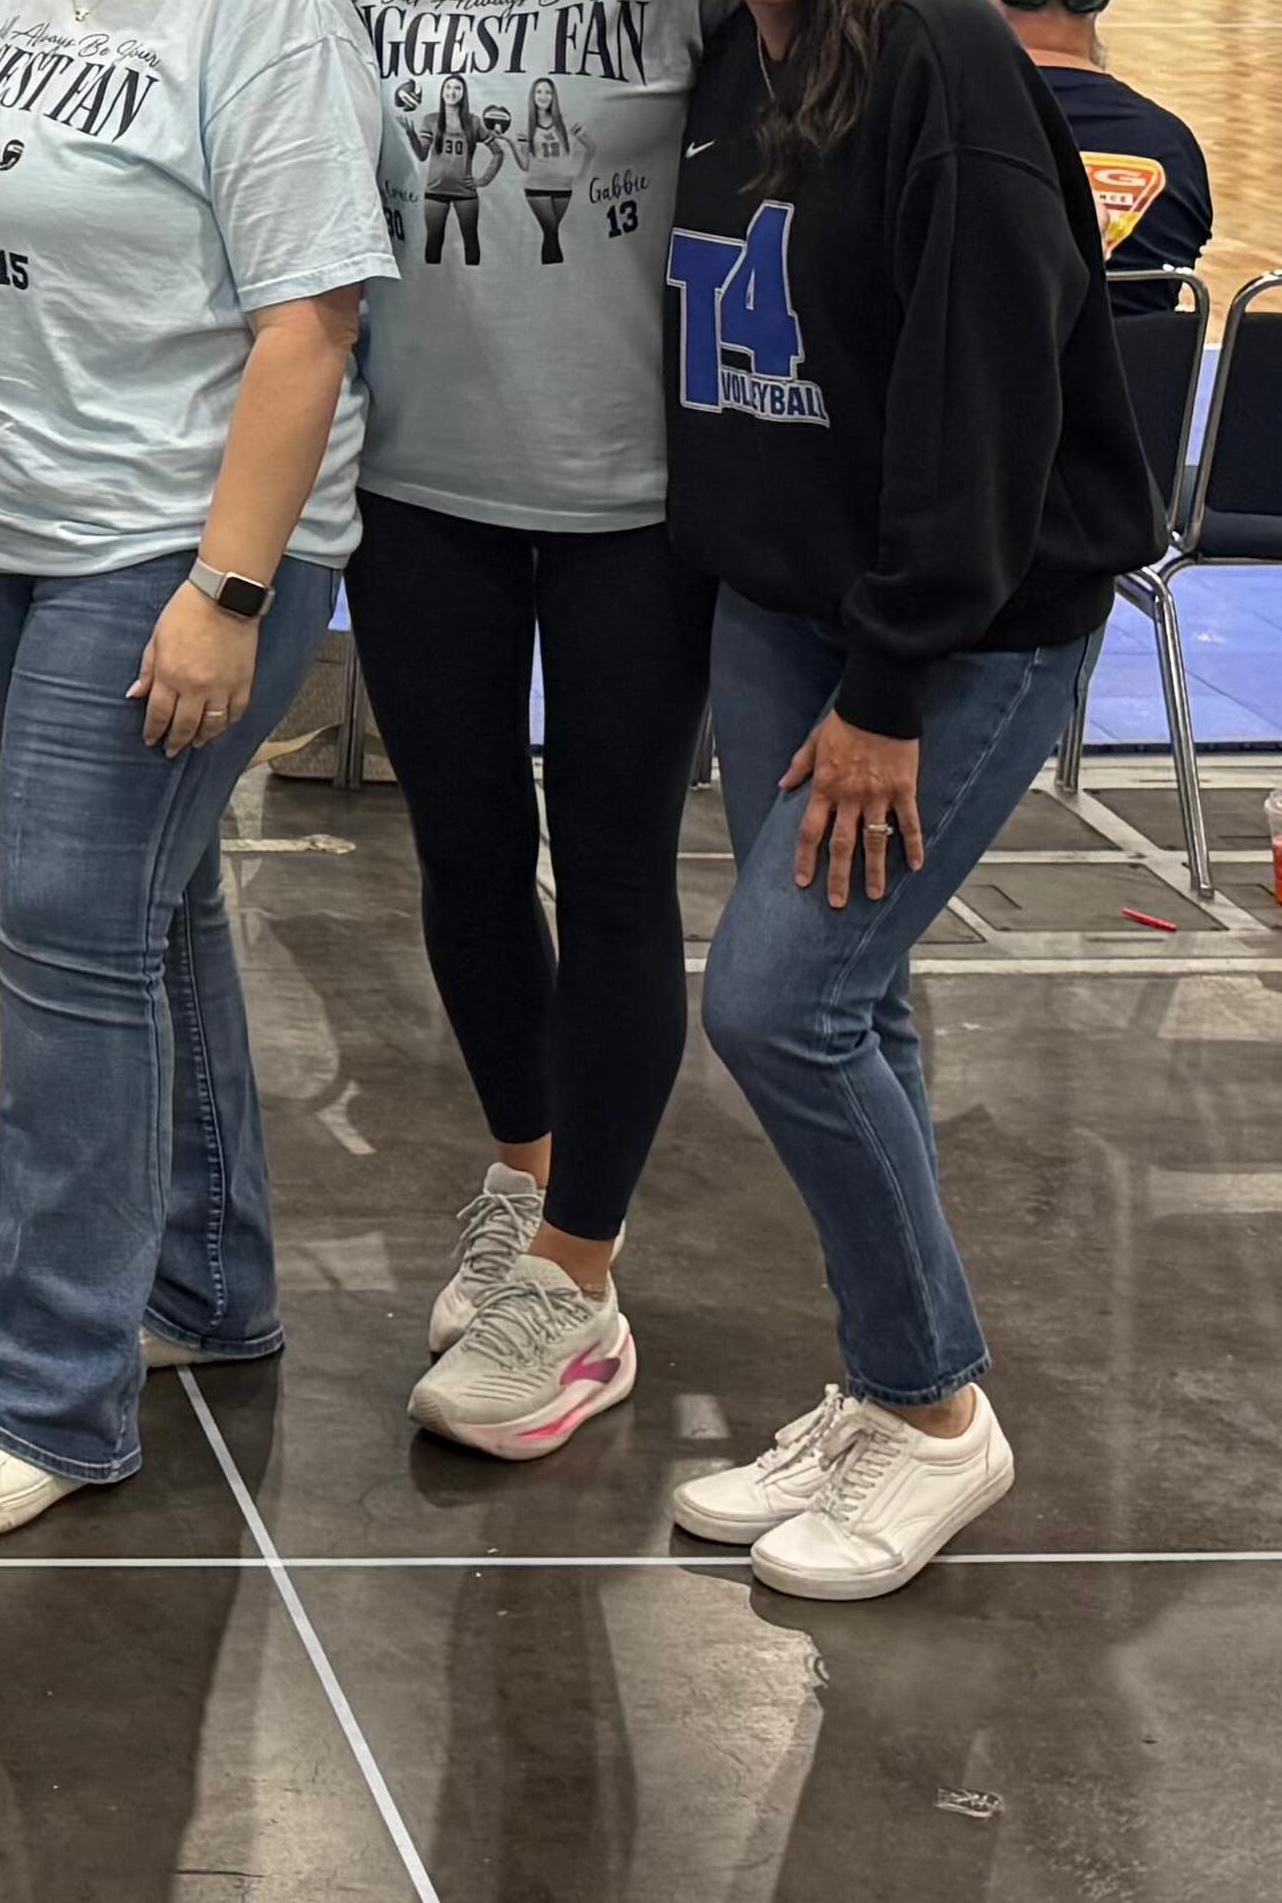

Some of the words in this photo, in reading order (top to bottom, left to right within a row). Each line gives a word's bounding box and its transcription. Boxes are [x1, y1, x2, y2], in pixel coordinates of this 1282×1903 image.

[12, 20, 77, 49] Always
[77, 33, 111, 58] Be
[548, 0, 650, 87] FAN
[44, 61, 160, 143] FAN
[606, 199, 638, 238] 13
[666, 199, 805, 414] T4
